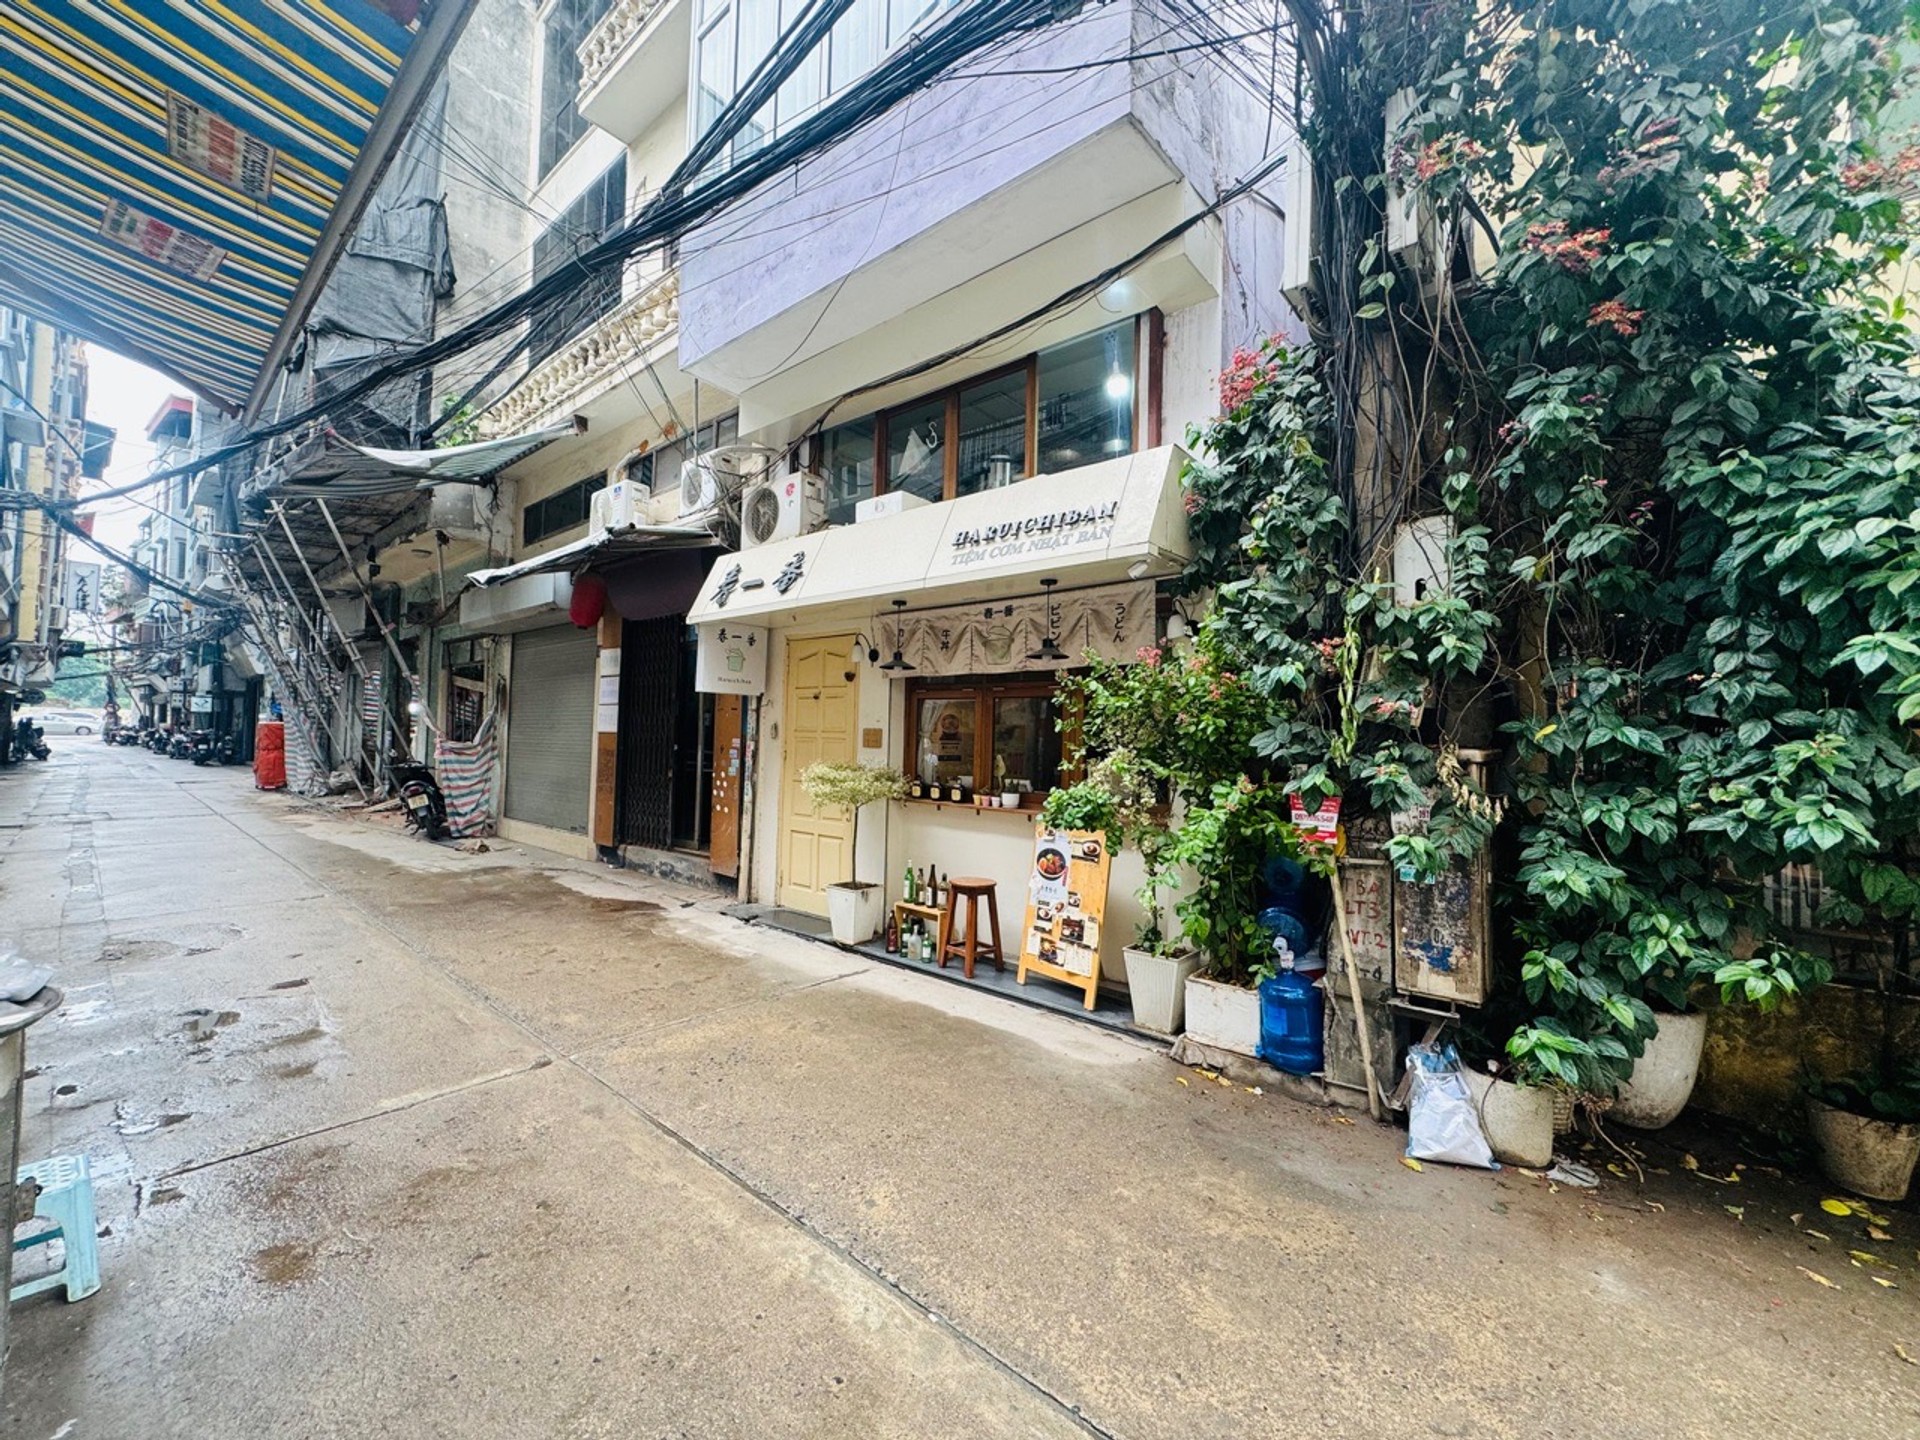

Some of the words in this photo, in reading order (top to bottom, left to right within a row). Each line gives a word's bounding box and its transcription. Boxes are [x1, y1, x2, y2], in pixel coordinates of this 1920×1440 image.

[952, 501, 1118, 547] HARUICHIBAN
[952, 548, 988, 566] TIỆM
[989, 541, 1026, 559] CƠM
[1027, 533, 1074, 552] NHẬT
[710, 551, 805, 608] 春一番
[984, 604, 1014, 619] 春一番
[1050, 602, 1062, 652] ビビン
[1112, 602, 1126, 643] うどん
[716, 626, 758, 647] 春一番
